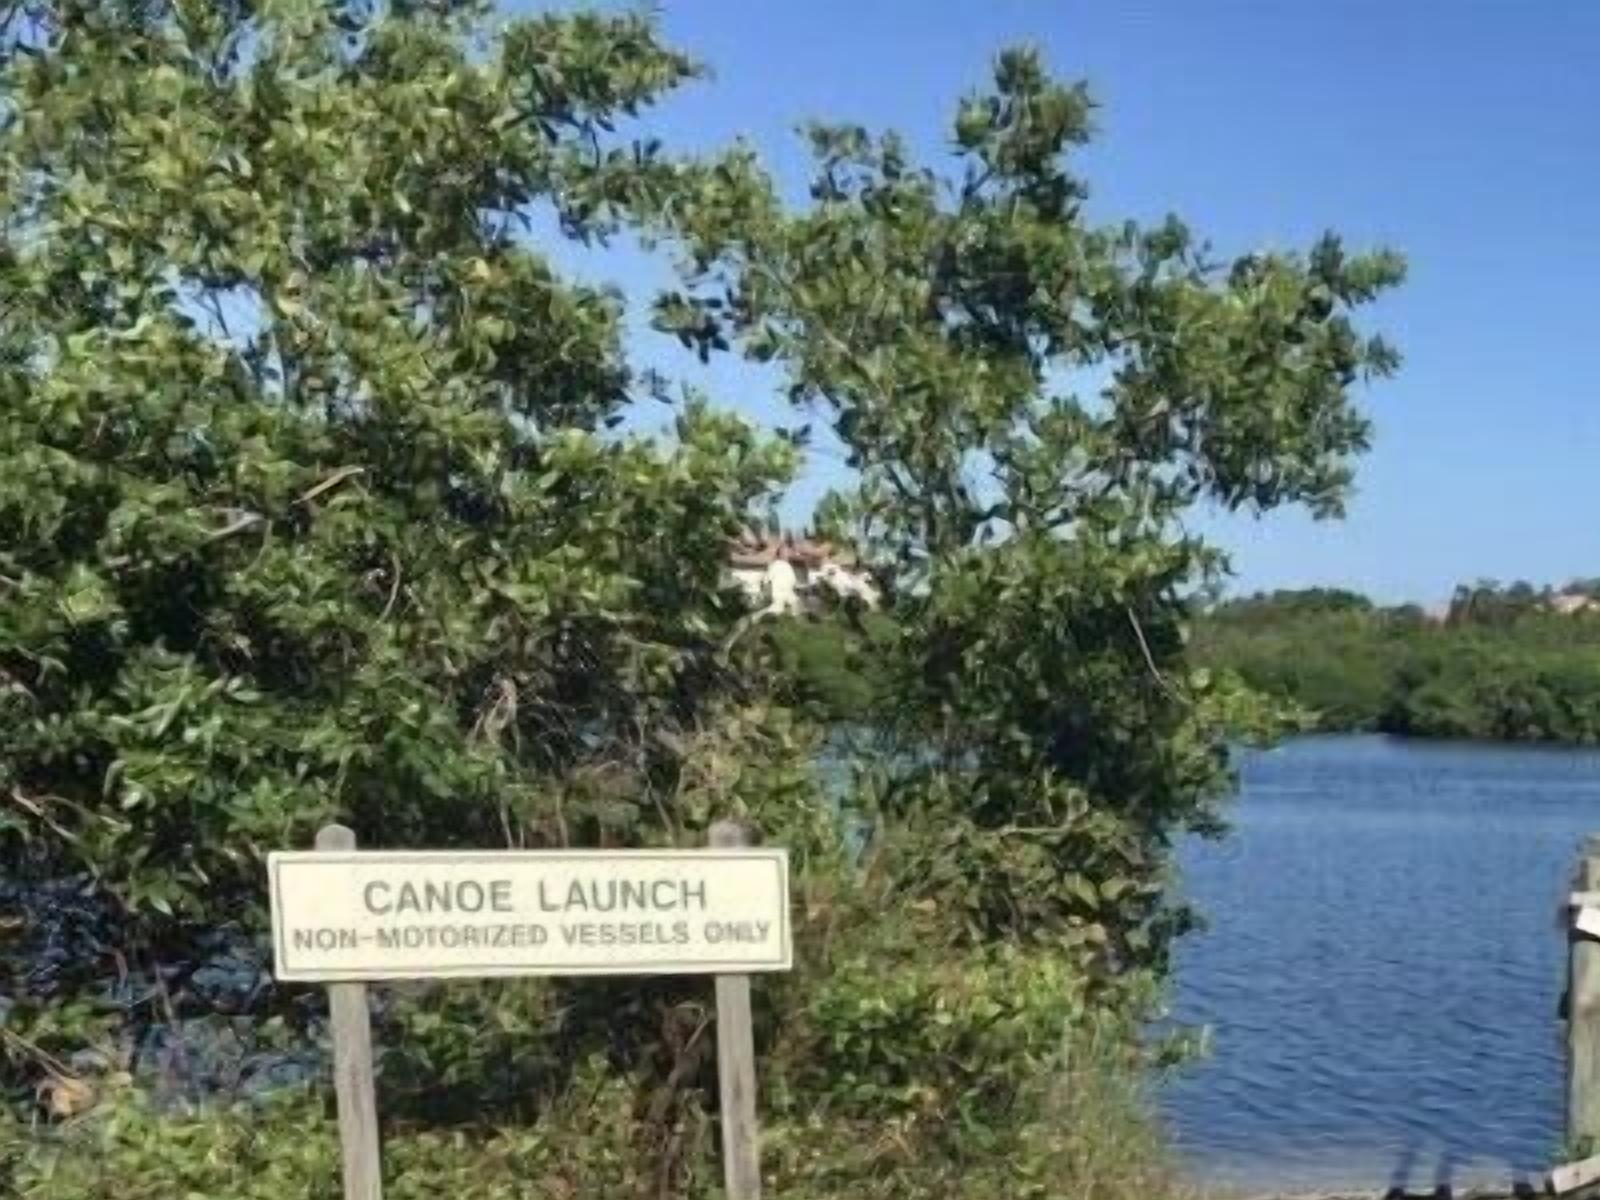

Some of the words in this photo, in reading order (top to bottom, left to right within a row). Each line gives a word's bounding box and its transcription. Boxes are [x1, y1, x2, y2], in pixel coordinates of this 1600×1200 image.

[363, 879, 513, 915] CANOE
[537, 879, 707, 912] LAUNCH
[293, 924, 548, 949] NON-MOTORIZED
[560, 921, 690, 945] VESSELS
[703, 920, 771, 944] ONLY
